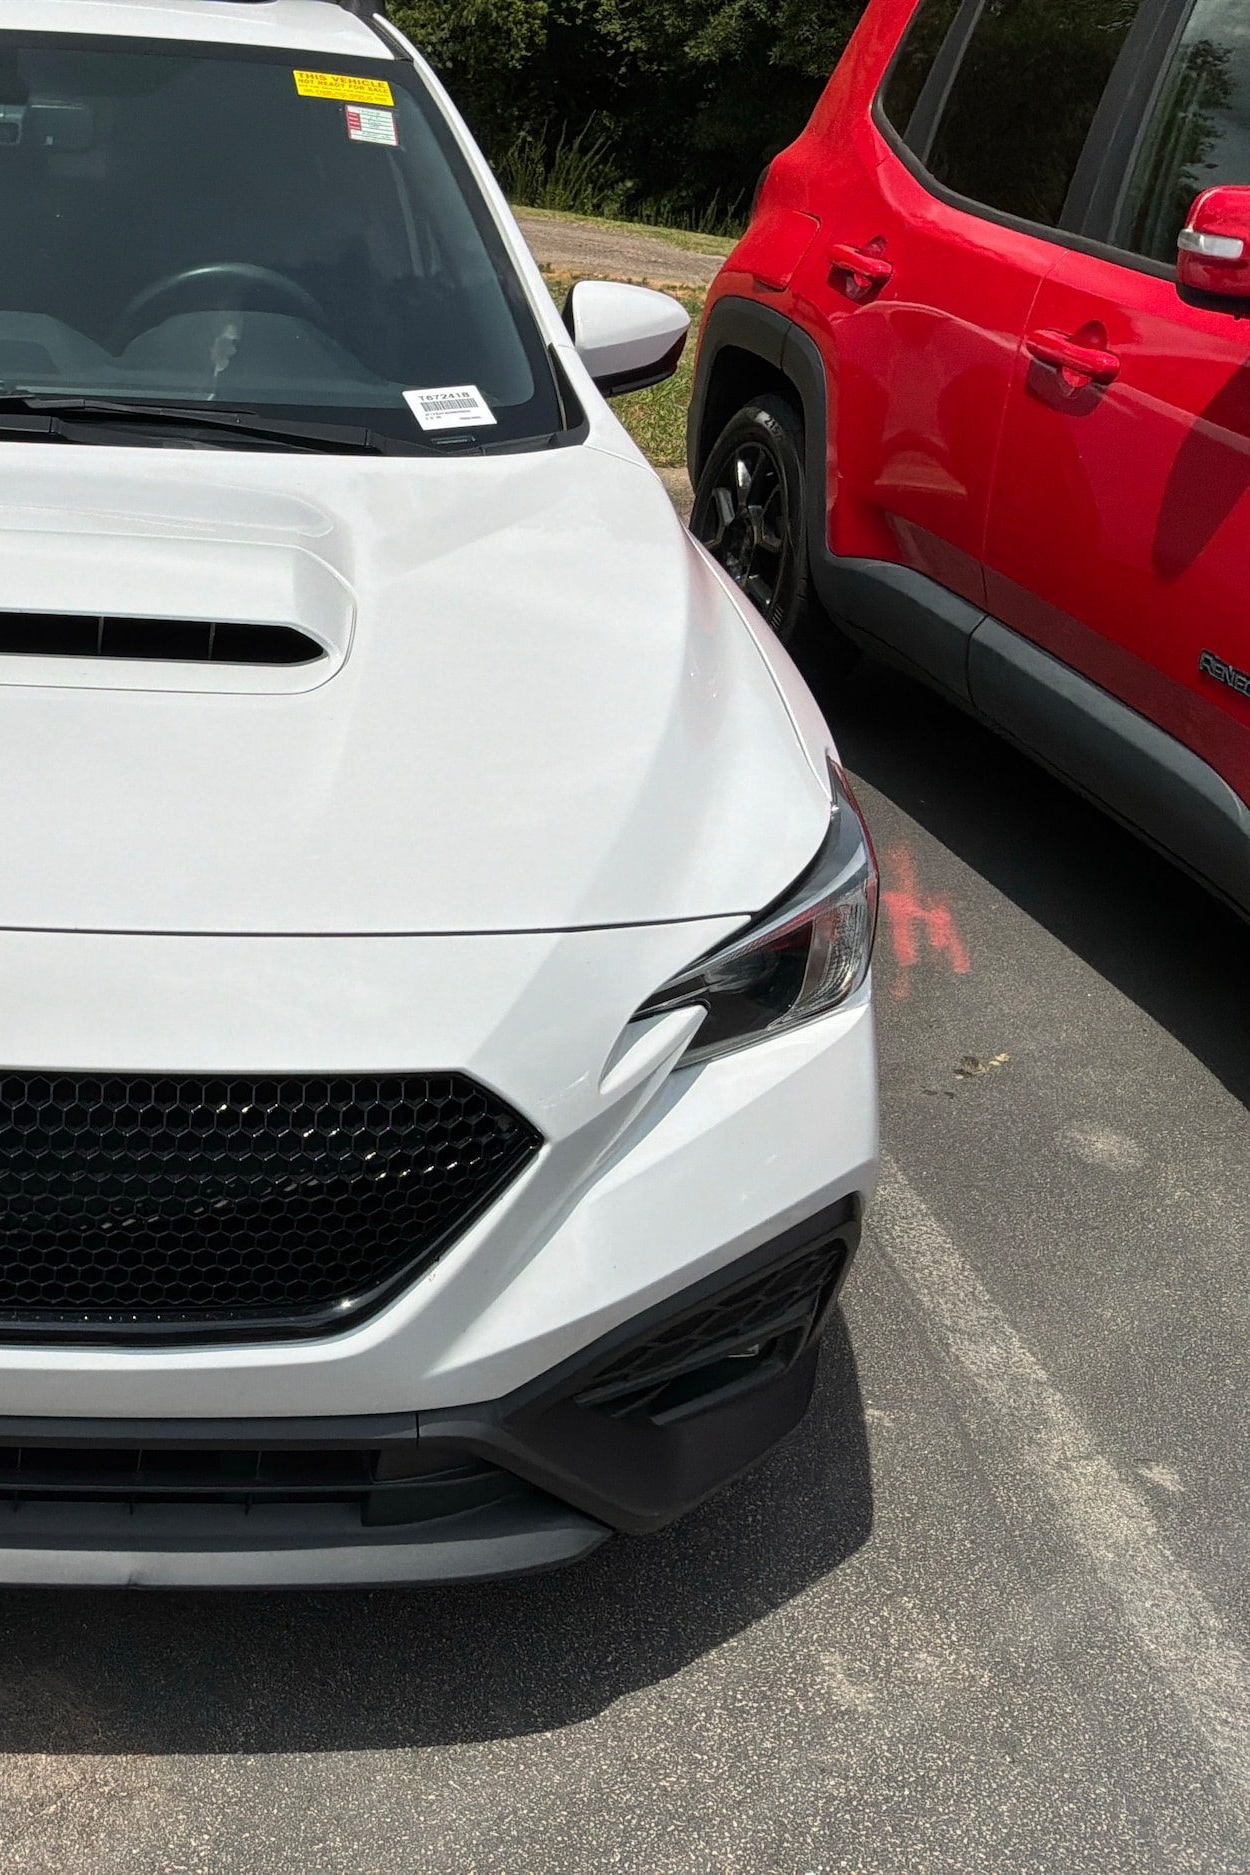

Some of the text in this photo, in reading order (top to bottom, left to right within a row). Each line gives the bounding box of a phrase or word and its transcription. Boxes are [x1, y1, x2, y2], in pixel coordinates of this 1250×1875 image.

[297, 72, 385, 88] THIS VEHICLE
[317, 80, 345, 88] READY
